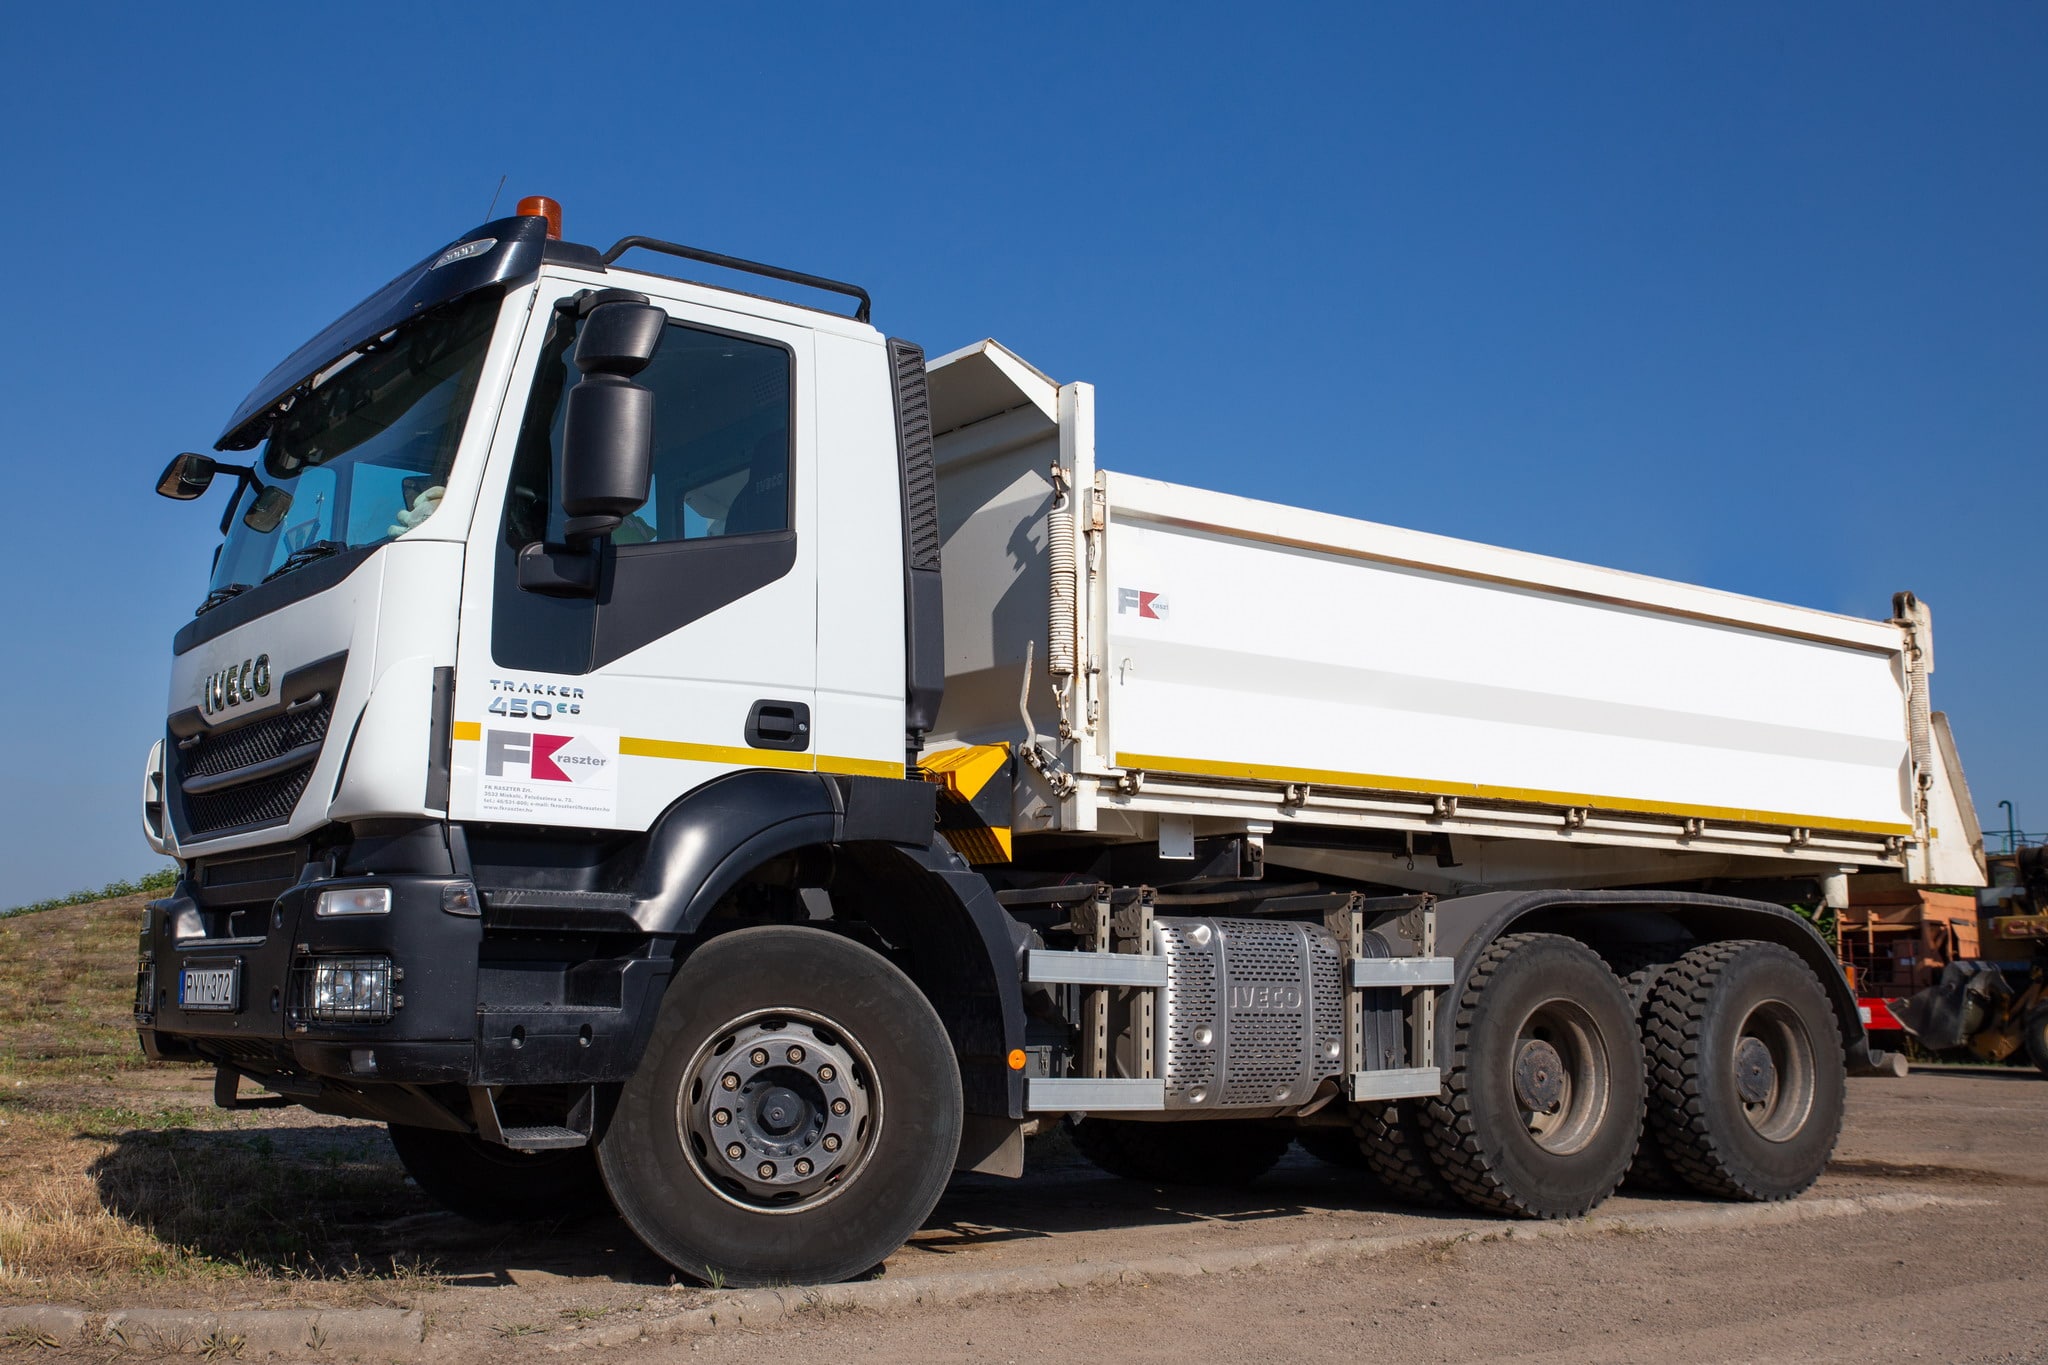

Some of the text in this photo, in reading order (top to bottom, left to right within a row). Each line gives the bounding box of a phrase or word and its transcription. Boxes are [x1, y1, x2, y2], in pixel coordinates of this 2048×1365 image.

[205, 653, 271, 715] IVECO
[490, 679, 584, 699] TRAKKER
[488, 696, 581, 720] 450 E6
[557, 754, 606, 766] raszter
[186, 973, 230, 1001] PYY-372
[1230, 986, 1302, 1009] IVECO
